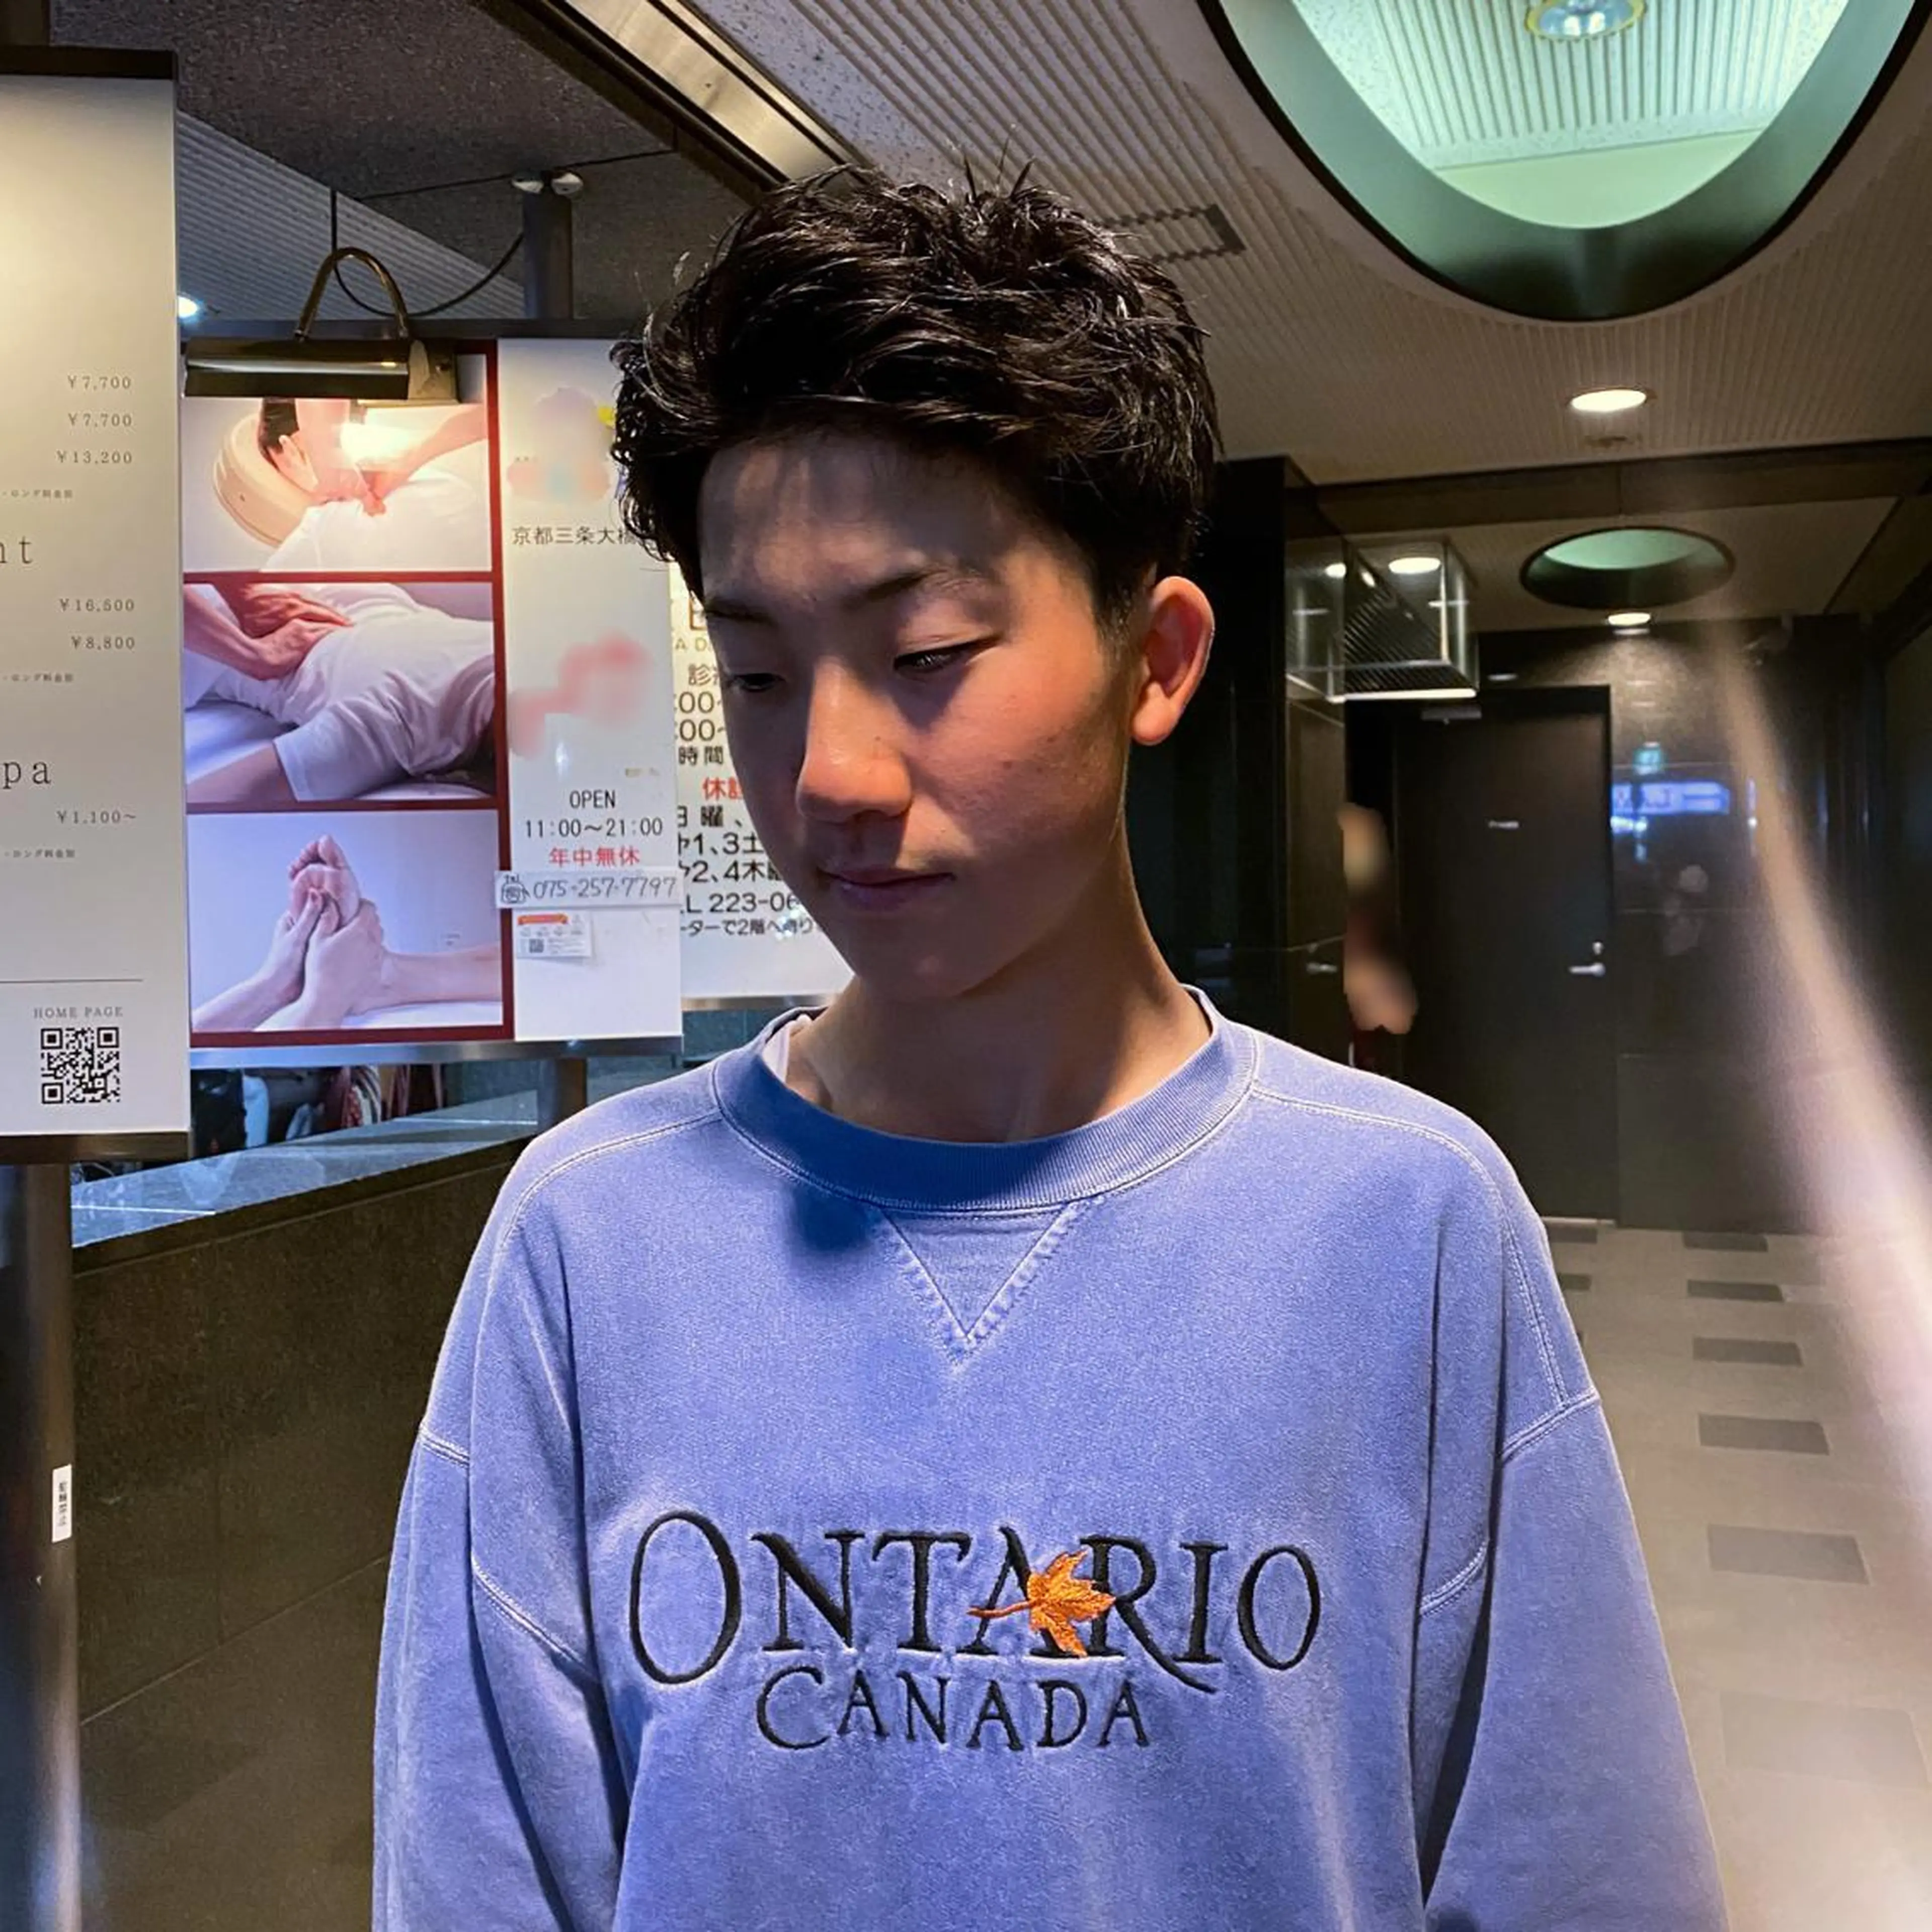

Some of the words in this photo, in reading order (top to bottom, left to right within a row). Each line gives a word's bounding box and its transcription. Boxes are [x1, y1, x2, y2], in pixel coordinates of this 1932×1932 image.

[67, 375, 131, 390] ¥7,700
[56, 450, 132, 465] ¥13,200
[569, 789, 616, 809] OPEN
[526, 817, 663, 838] 11:00〜21:00
[549, 846, 640, 868] 年中無休
[34, 1007, 77, 1019] HOME
[85, 1006, 123, 1018] PAGE
[629, 1510, 1321, 1694] ONTARIO
[757, 1666, 1151, 1751] CANADA
